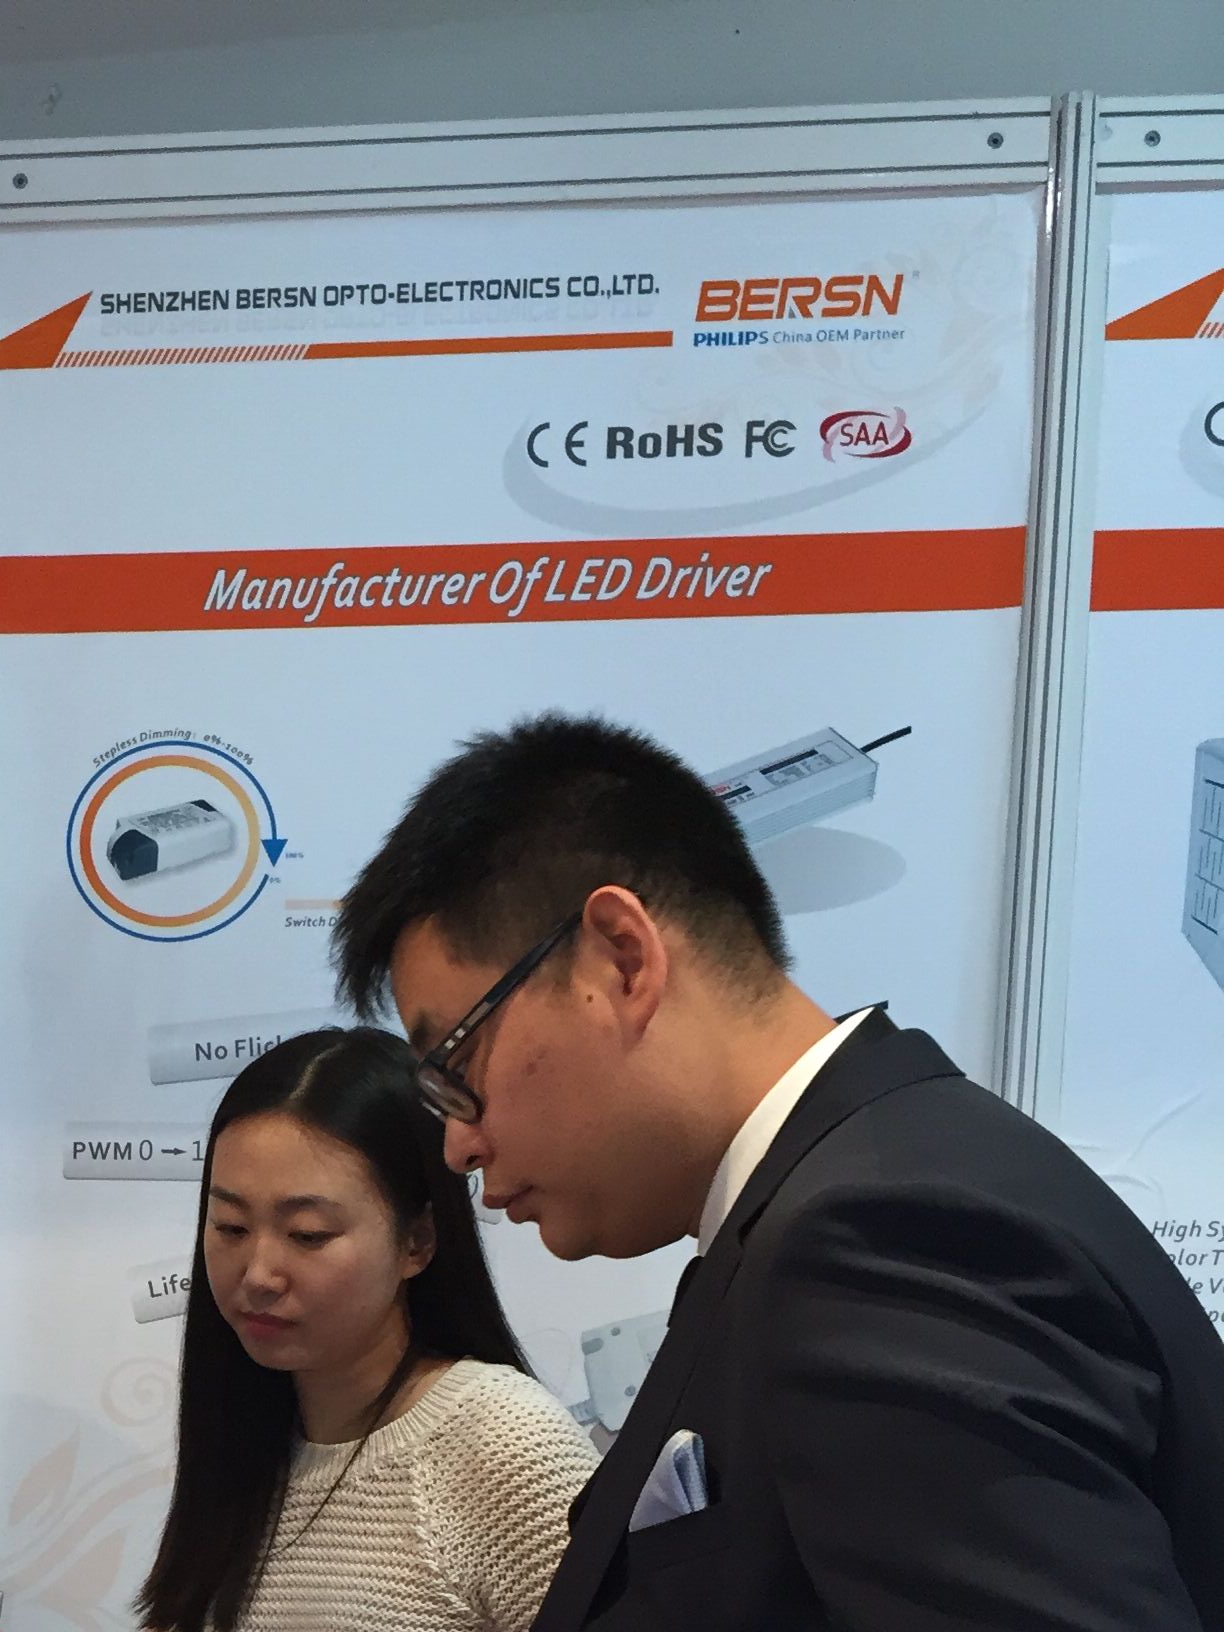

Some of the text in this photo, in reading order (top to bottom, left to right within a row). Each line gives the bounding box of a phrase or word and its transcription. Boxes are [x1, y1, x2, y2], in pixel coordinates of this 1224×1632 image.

[100, 290, 229, 315] SHENZHEN
[236, 285, 316, 310] BERSN
[323, 276, 560, 307] OPTO-ELECTRONICS
[695, 274, 904, 322] BERSN
[693, 326, 906, 347] PHILIPS China OEM Partner
[606, 422, 723, 459] RoHS
[839, 420, 889, 447] SAA
[204, 552, 773, 622] Manufacturer Of LED Driver
[92, 734, 137, 768] Stepless
[284, 915, 325, 928] Switch
[195, 1036, 281, 1062] No Flic
[72, 1141, 132, 1160] PWM
[1152, 1219, 1201, 1243] High
[1168, 1248, 1208, 1266] olor
